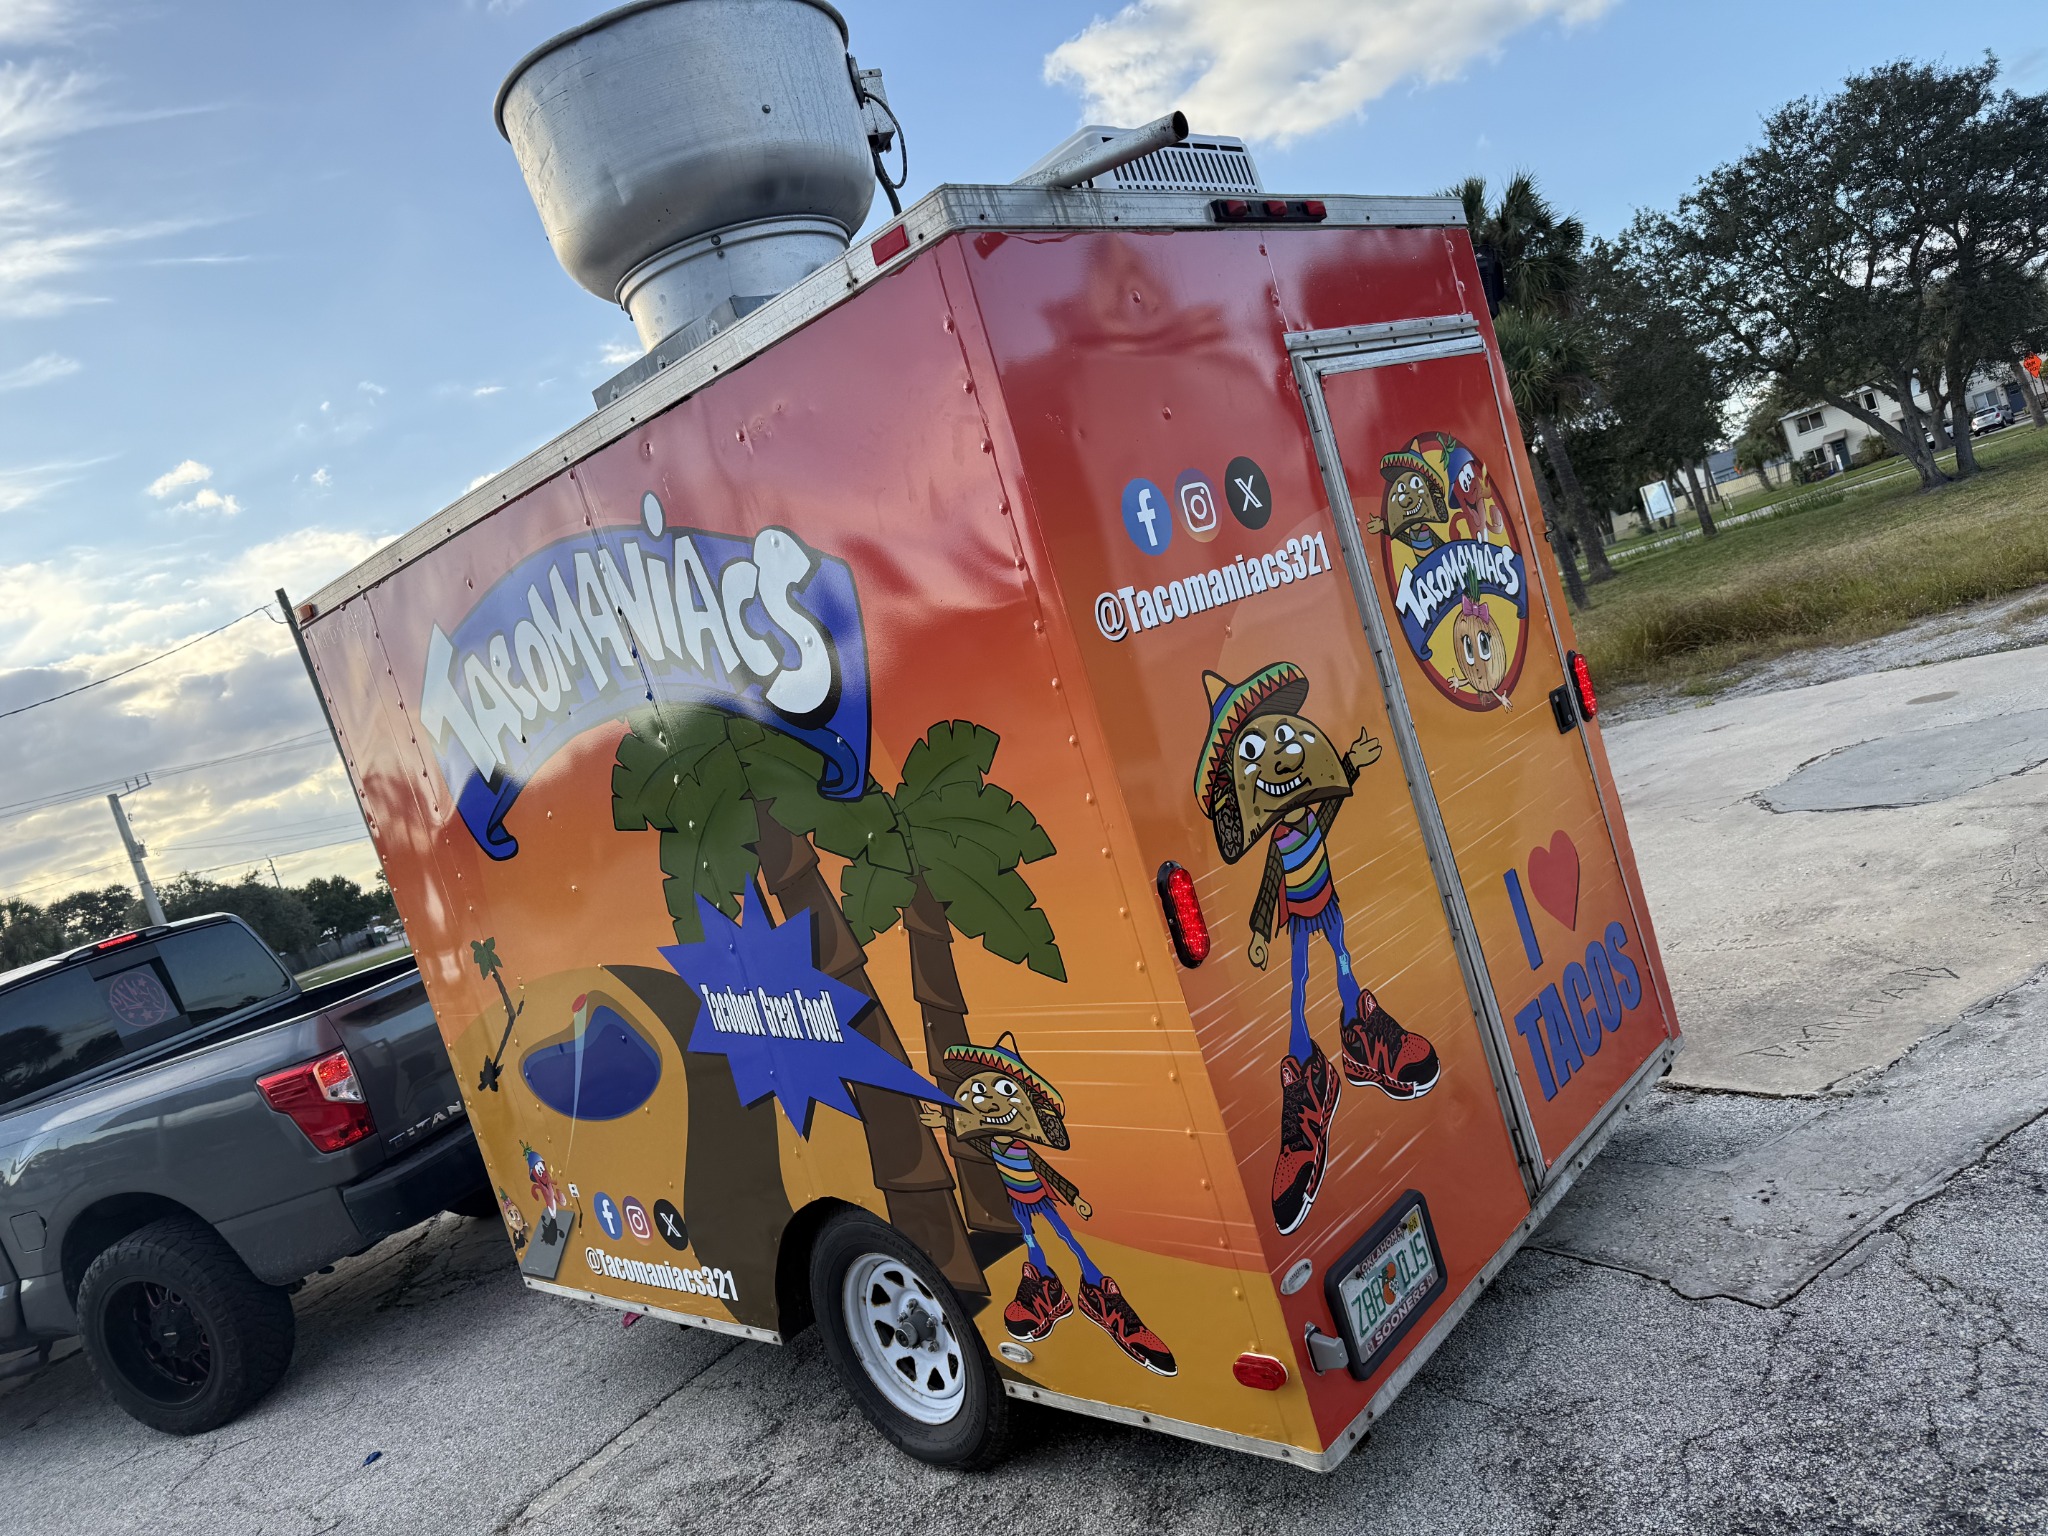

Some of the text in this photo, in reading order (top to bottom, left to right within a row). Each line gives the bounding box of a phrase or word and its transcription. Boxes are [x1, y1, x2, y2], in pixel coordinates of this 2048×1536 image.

[1094, 531, 1332, 642] @Tacomaniacs321
[1503, 868, 1543, 971] I
[700, 984, 844, 1043] Tacobout Great Food!
[1513, 920, 1642, 1102] TACOS
[585, 1246, 739, 1301] @Tacomaniacs321
[1361, 1227, 1403, 1273] OKLAHOMA
[1374, 1283, 1427, 1347] SOONERS
